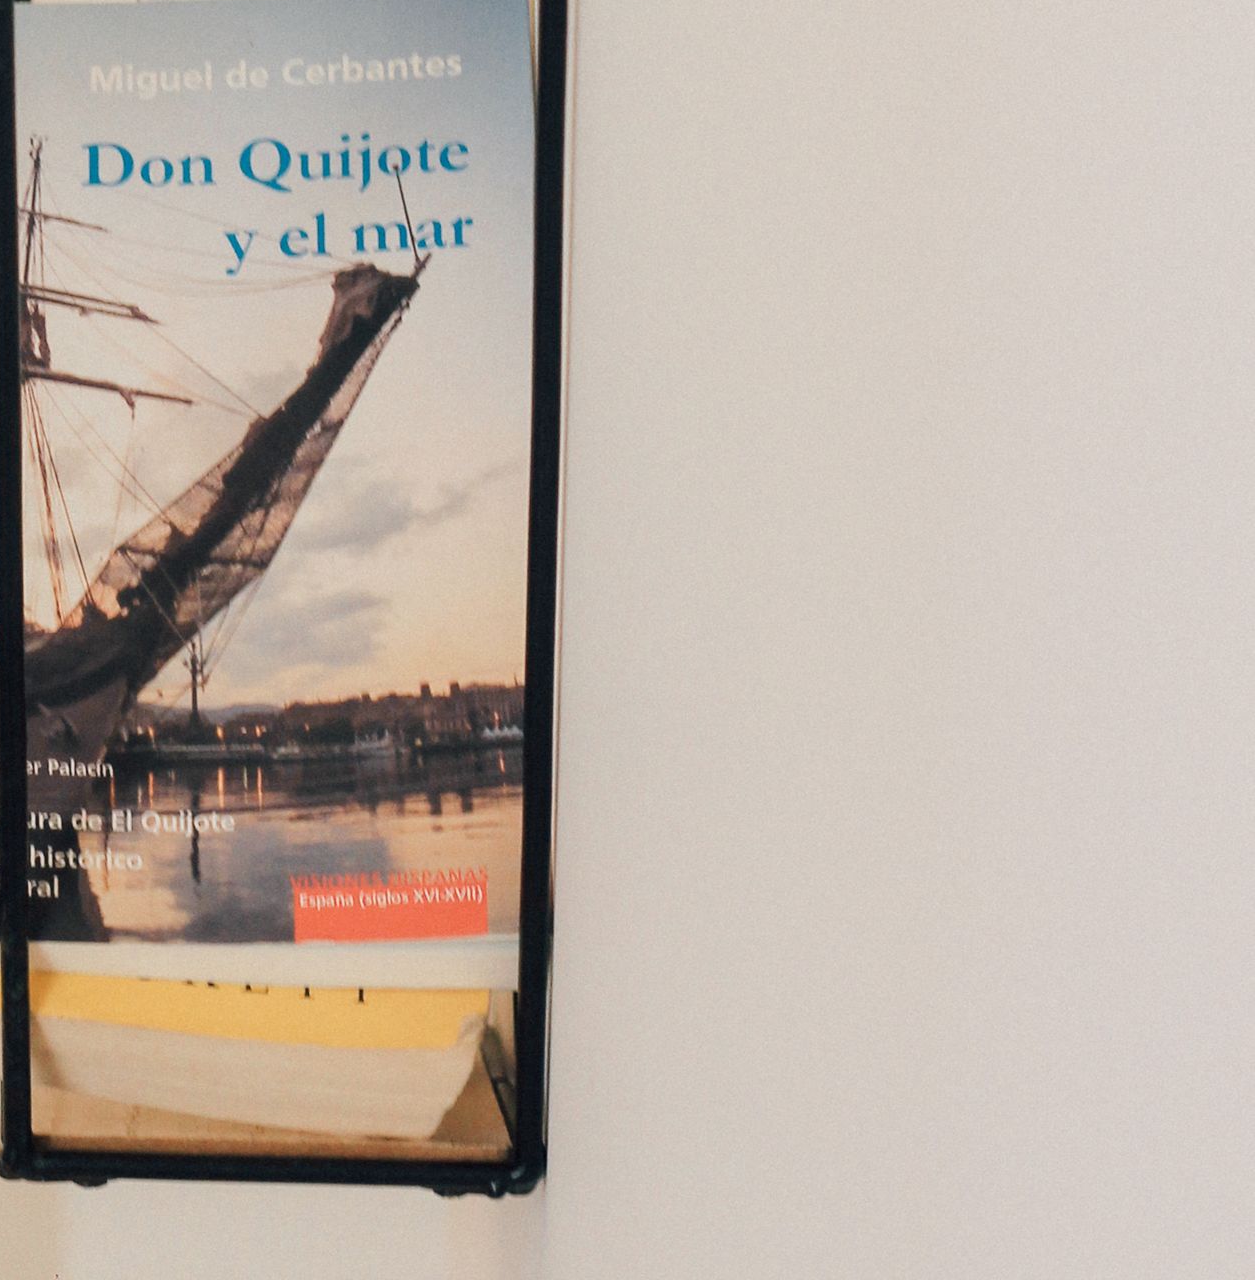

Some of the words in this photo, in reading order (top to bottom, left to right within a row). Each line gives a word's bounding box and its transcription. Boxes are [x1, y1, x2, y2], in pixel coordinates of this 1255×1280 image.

[90, 60, 213, 100] Miguel
[226, 61, 270, 91] de
[281, 51, 463, 87] Cerbantes
[81, 142, 217, 188] Don
[239, 132, 471, 193] Quijote
[224, 230, 258, 277] y
[279, 211, 331, 258] el
[351, 215, 474, 254] mar
[48, 757, 115, 778] Palacín
[71, 807, 103, 832] de
[111, 808, 134, 833] El
[141, 808, 236, 839] Quijote
[29, 843, 145, 871] histórico
[299, 889, 354, 912] España
[359, 887, 409, 910] (siglos
